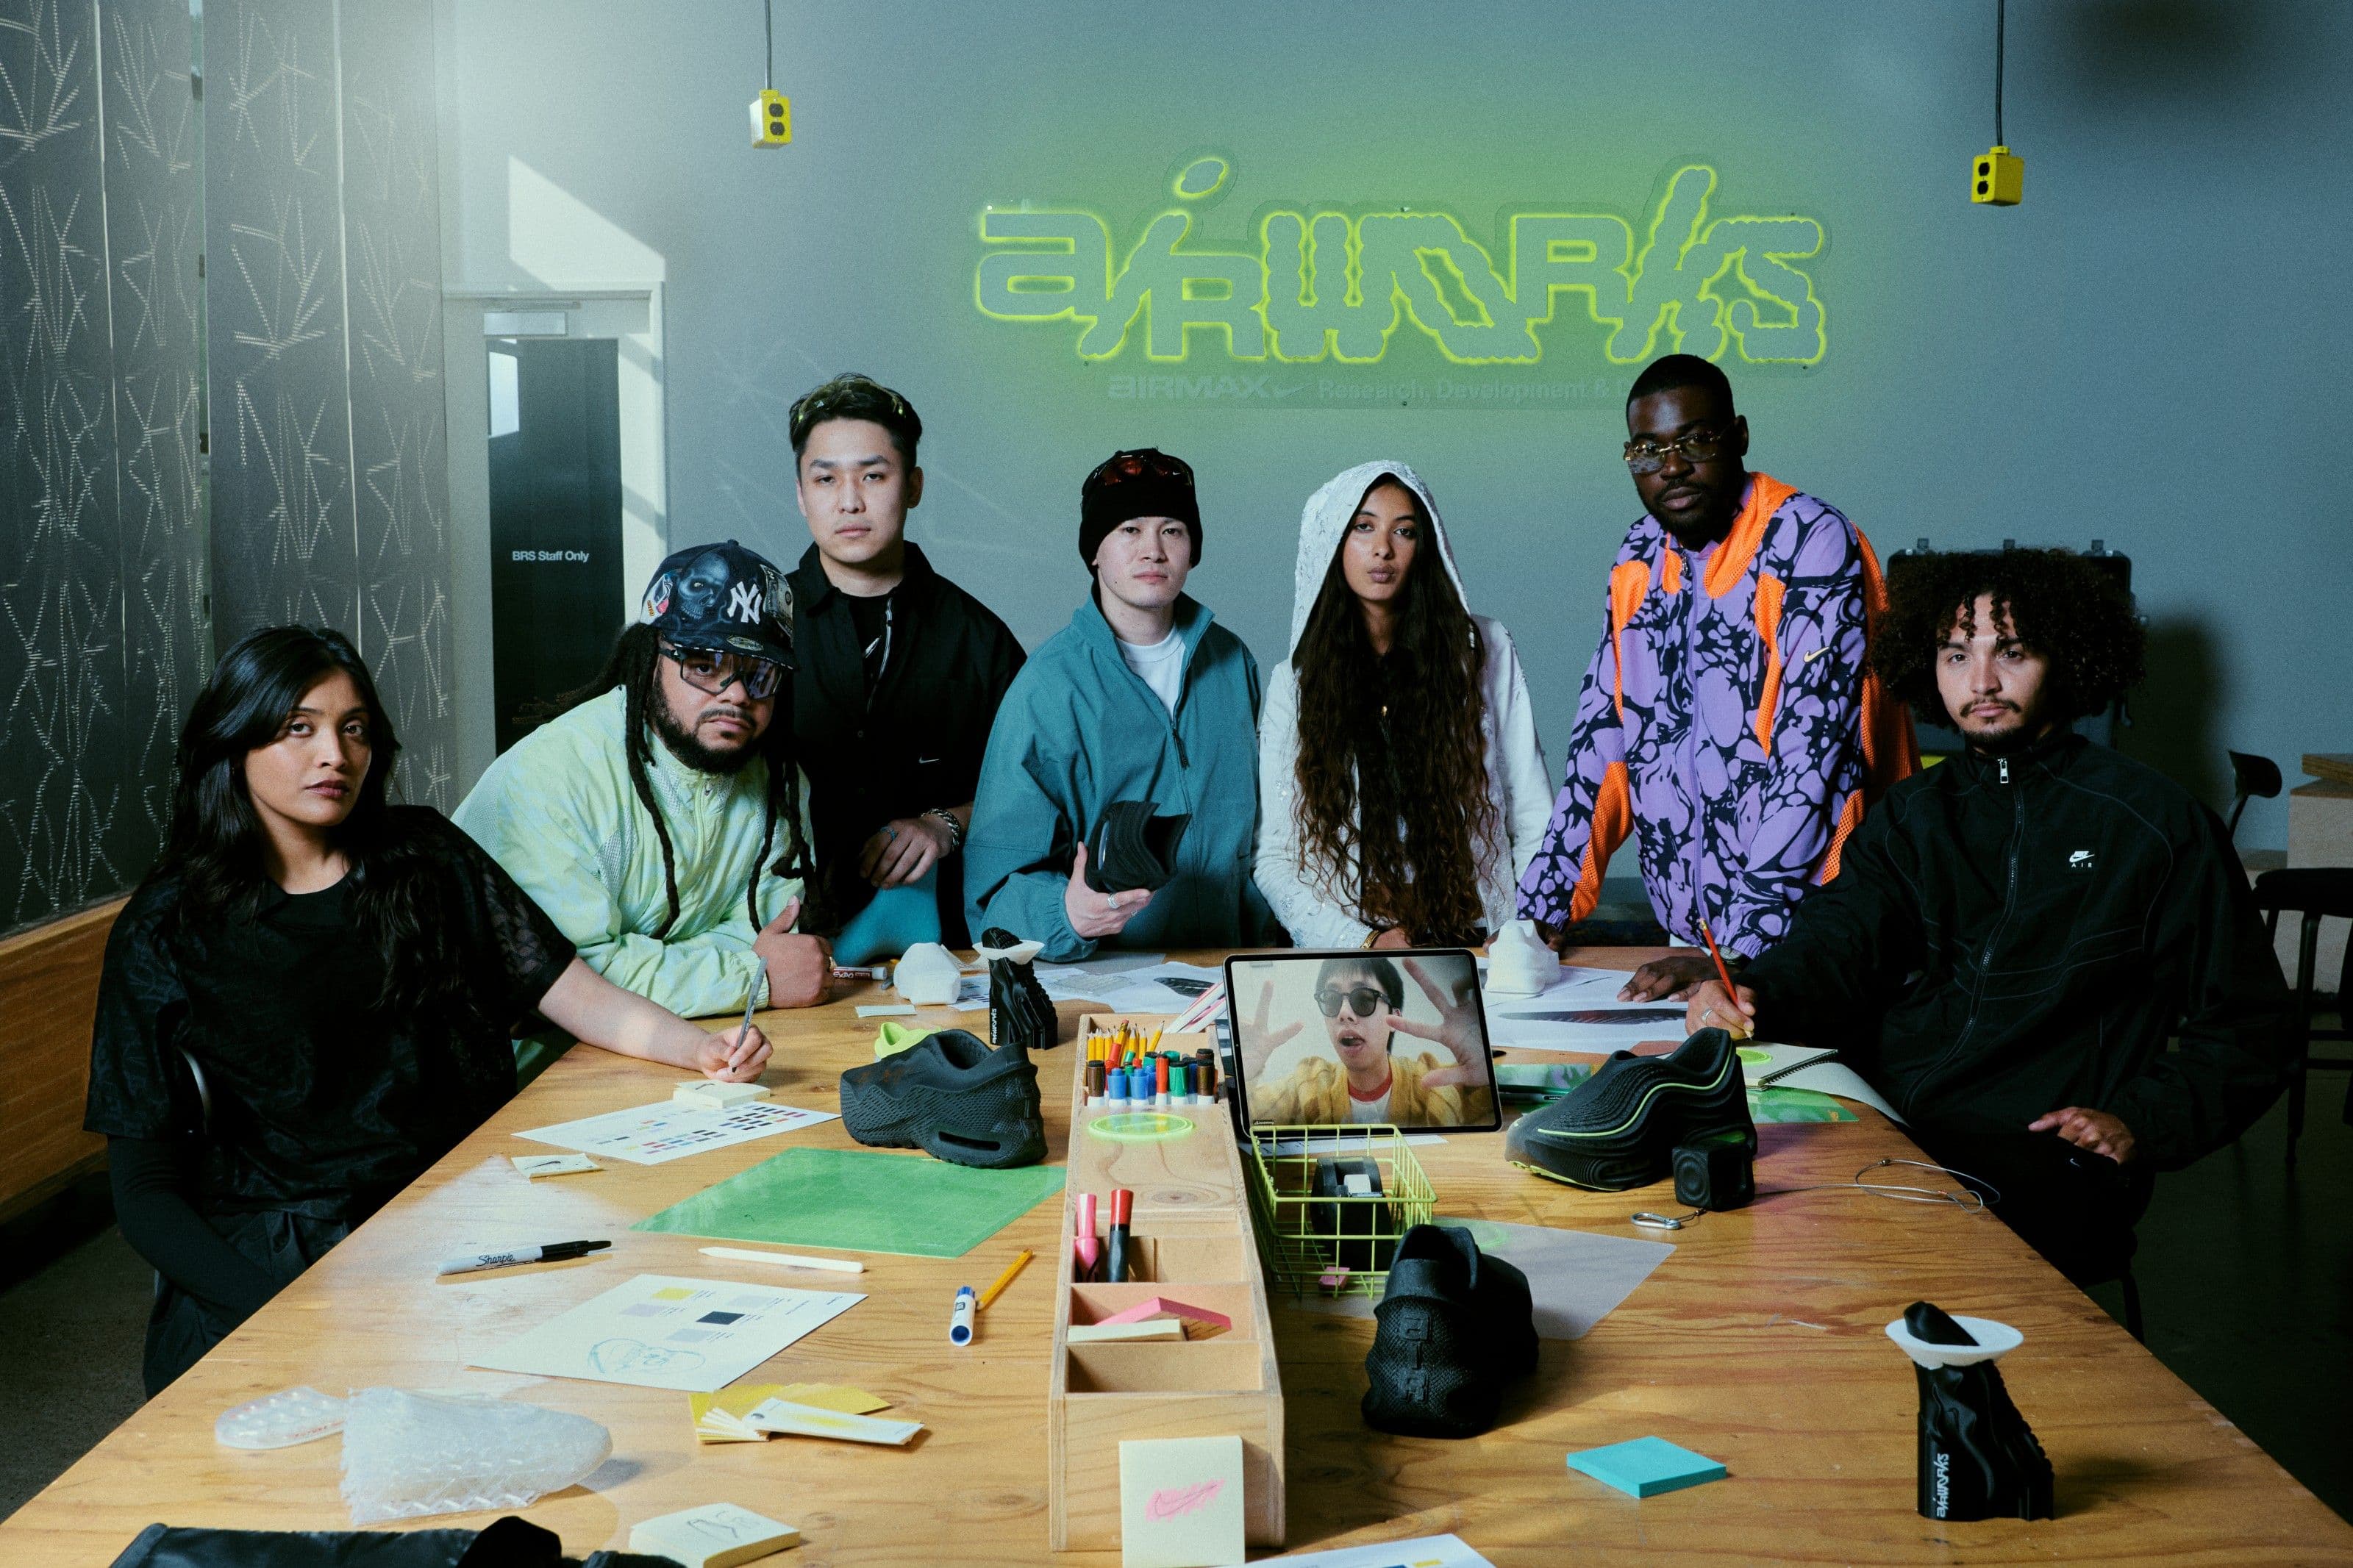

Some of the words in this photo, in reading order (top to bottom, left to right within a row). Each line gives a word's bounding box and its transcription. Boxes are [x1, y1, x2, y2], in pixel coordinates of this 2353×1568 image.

[1436, 379, 1587, 403] Development
[1595, 377, 1610, 398] &
[512, 551, 536, 561] BRS
[538, 551, 563, 561] Staff
[565, 551, 590, 563] Only
[726, 581, 763, 625] NY
[476, 1252, 515, 1267] Sharpie
